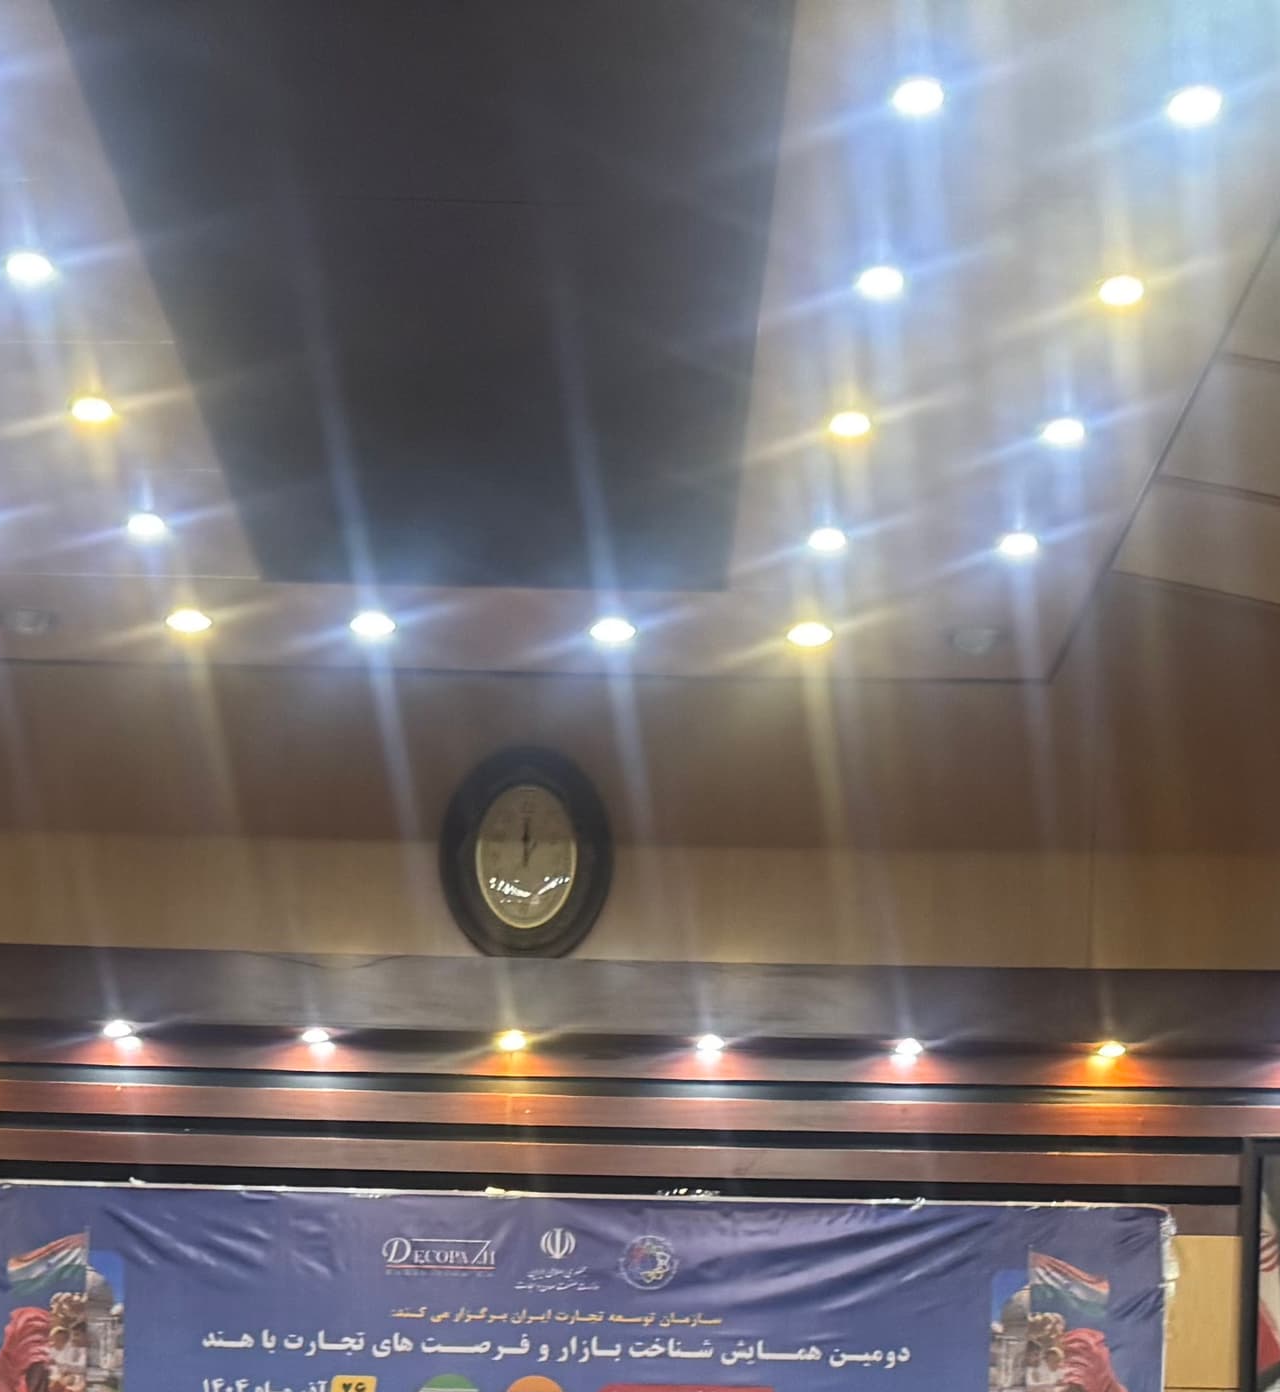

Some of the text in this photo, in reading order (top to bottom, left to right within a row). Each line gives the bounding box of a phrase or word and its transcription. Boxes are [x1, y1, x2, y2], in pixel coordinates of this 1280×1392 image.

[430, 1310, 451, 1323] می
[454, 1306, 508, 1323] برگزار
[511, 1308, 552, 1325] ایران
[555, 1309, 604, 1325] تجارت
[607, 1311, 655, 1327] توسعه
[659, 1311, 722, 1327] سازمان
[202, 1329, 911, 1368] دومین همایش شناخت بازار و فرصت های تجارت با هند
